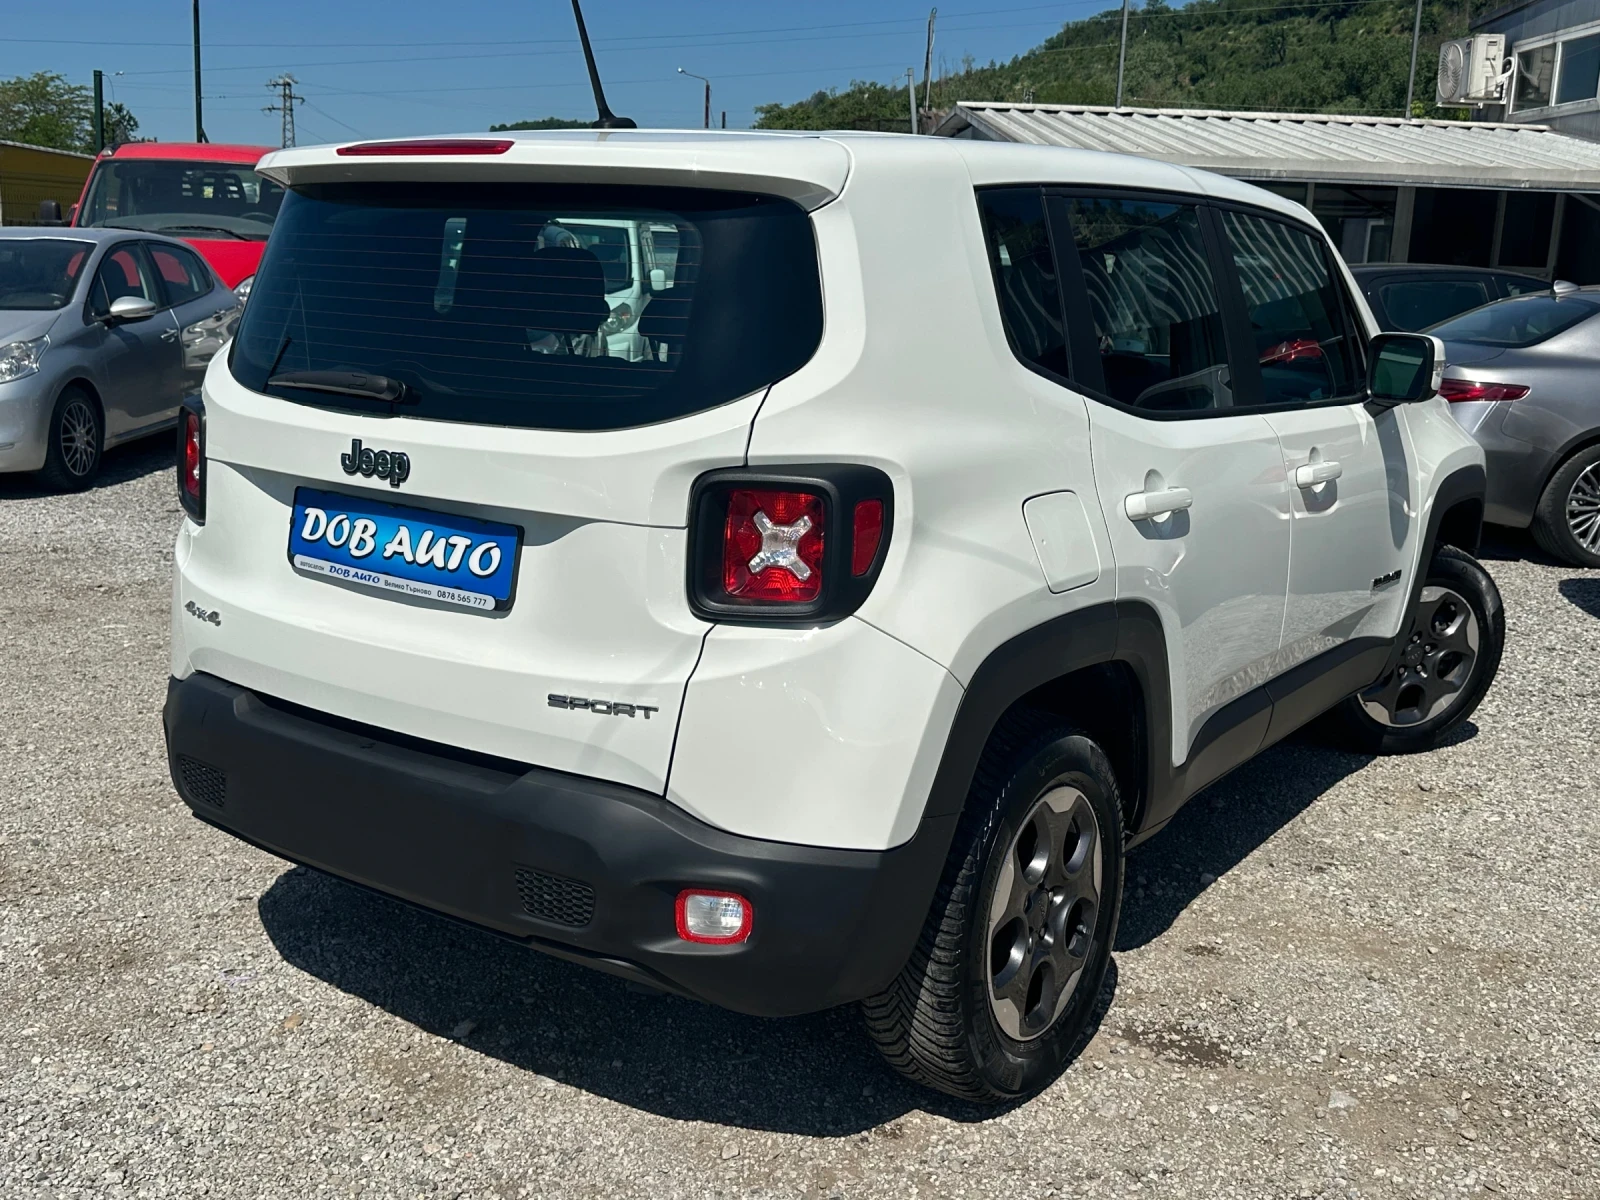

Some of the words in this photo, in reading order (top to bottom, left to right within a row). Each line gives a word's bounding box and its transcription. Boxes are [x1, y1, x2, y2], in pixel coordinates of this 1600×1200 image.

[341, 438, 410, 488] Jeep
[301, 507, 377, 558] DOB
[383, 526, 502, 577] AUTO
[329, 565, 350, 578] DOB
[352, 571, 380, 584] AUTO
[384, 579, 405, 591] Велико
[405, 583, 432, 596] Търново
[437, 589, 456, 601] 0878
[457, 594, 472, 604] 565
[473, 599, 487, 607] 777
[547, 693, 659, 719] SPORT
